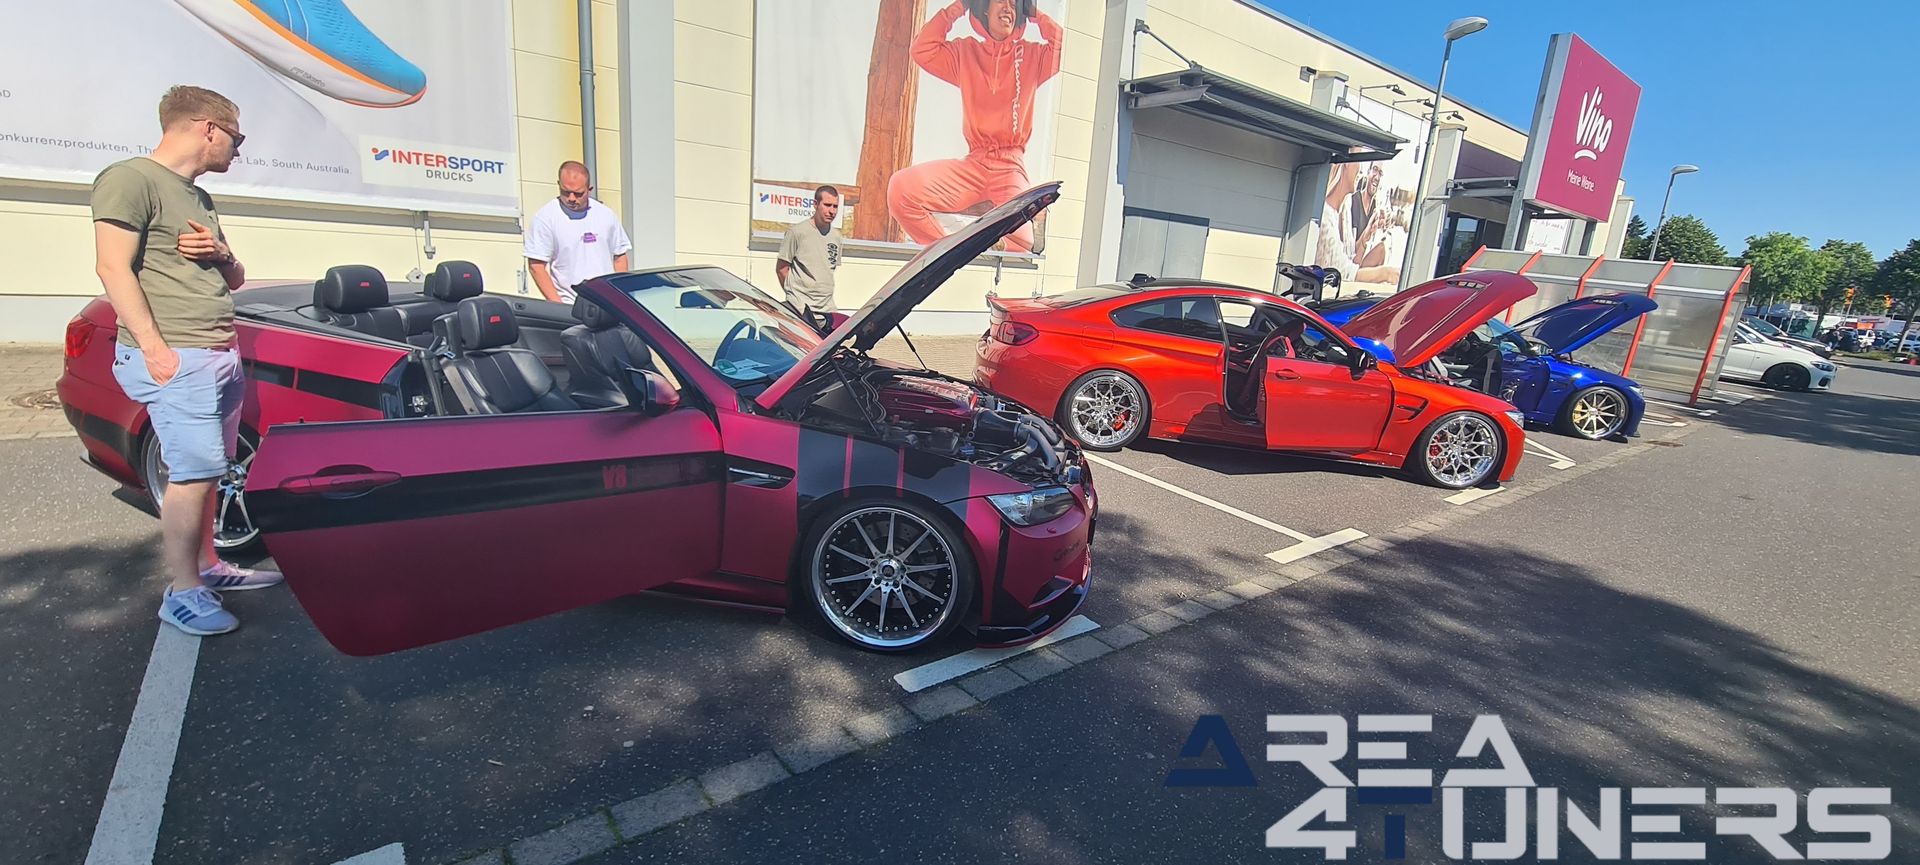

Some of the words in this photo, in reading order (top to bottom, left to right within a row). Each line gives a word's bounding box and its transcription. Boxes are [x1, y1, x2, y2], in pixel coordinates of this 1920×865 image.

[1012, 44, 1024, 135] Champion
[1576, 86, 1613, 153] Vino
[246, 156, 269, 168] Lab,
[271, 158, 303, 170] South
[391, 149, 505, 175] INTERSPORT
[426, 169, 474, 183] DRUCKS
[771, 194, 817, 209] INTERSP
